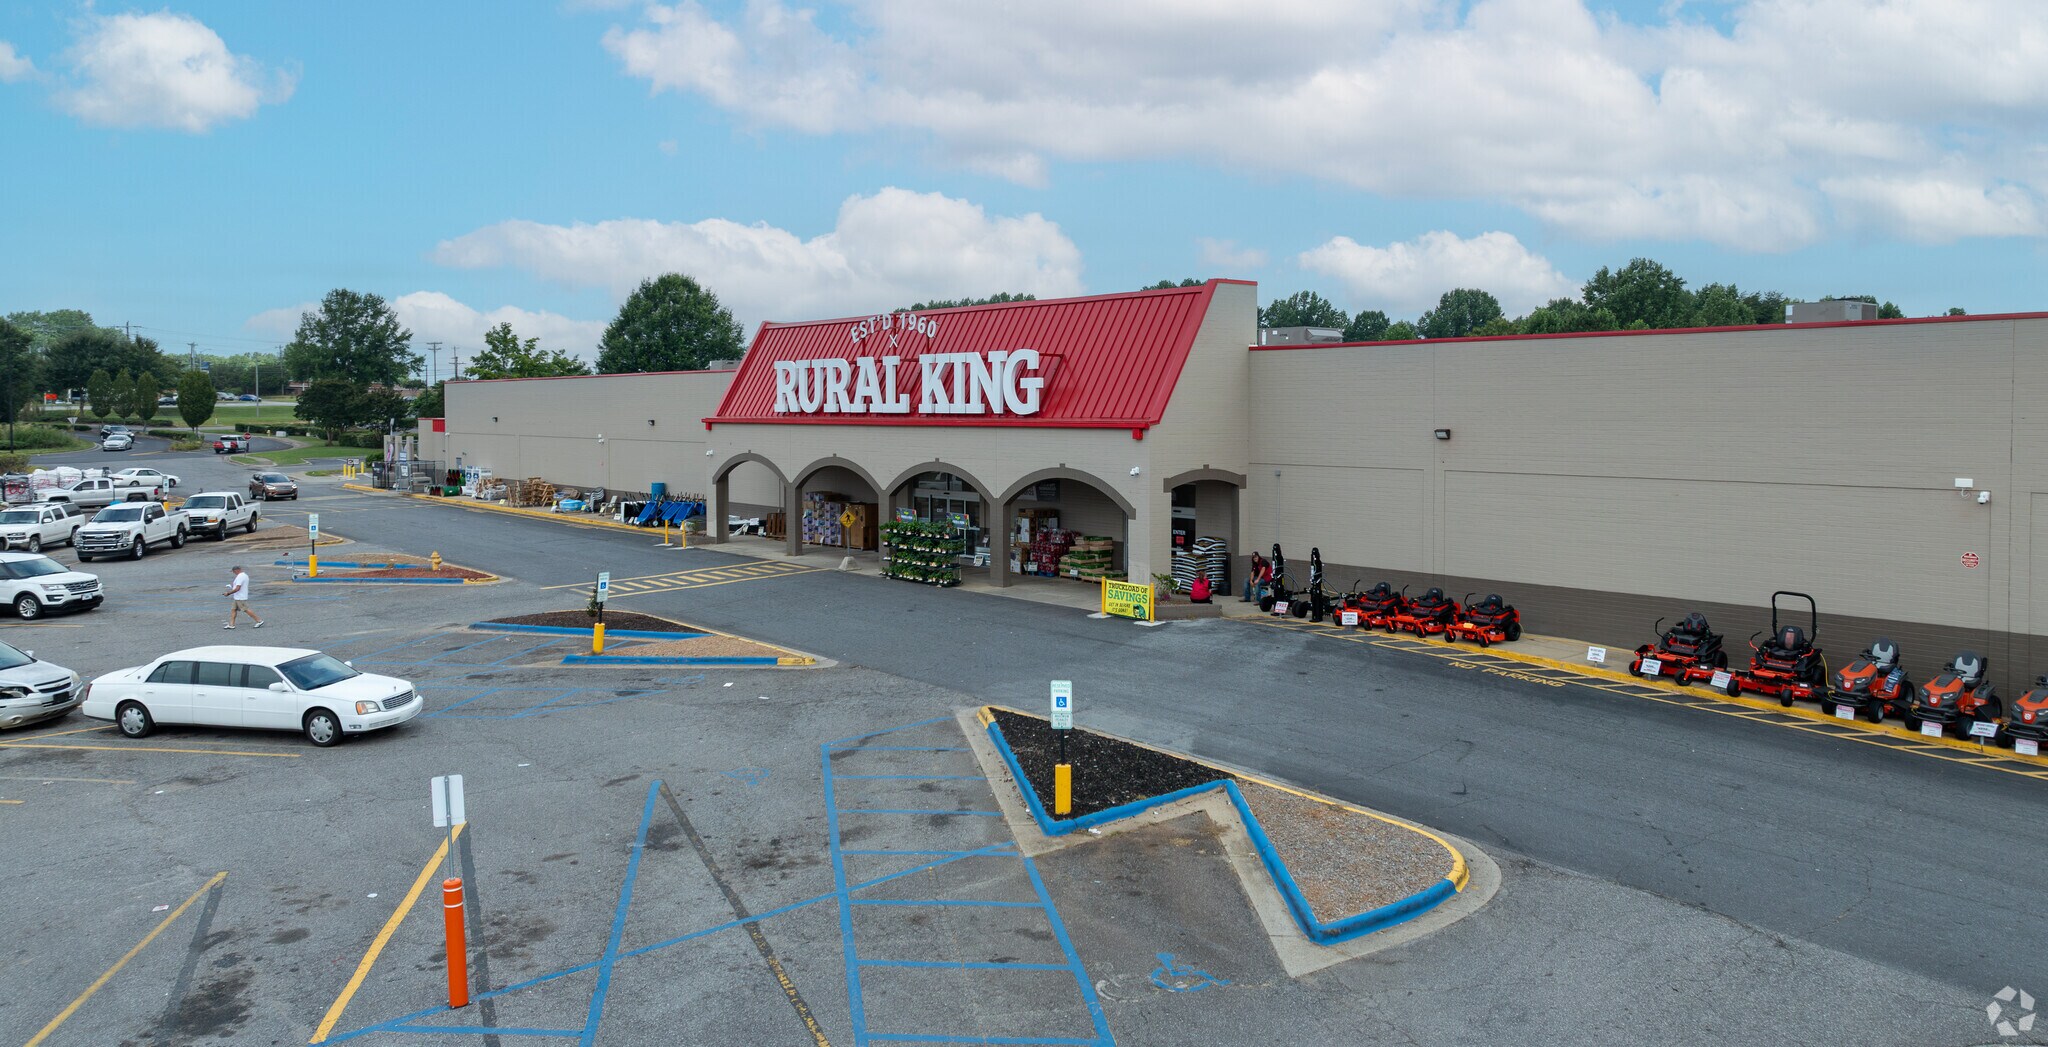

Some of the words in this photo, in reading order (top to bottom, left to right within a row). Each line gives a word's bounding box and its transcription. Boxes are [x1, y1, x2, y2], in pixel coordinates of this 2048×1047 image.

[851, 313, 892, 343] EST'D
[900, 313, 937, 338] 1960
[773, 355, 911, 414] RURAL
[918, 348, 1044, 416] KING
[1108, 589, 1147, 604] SAVINGS
[1109, 583, 1139, 592] TRUCKLOAD
[1448, 661, 1477, 670] NO
[1481, 668, 1566, 687] PARKING
